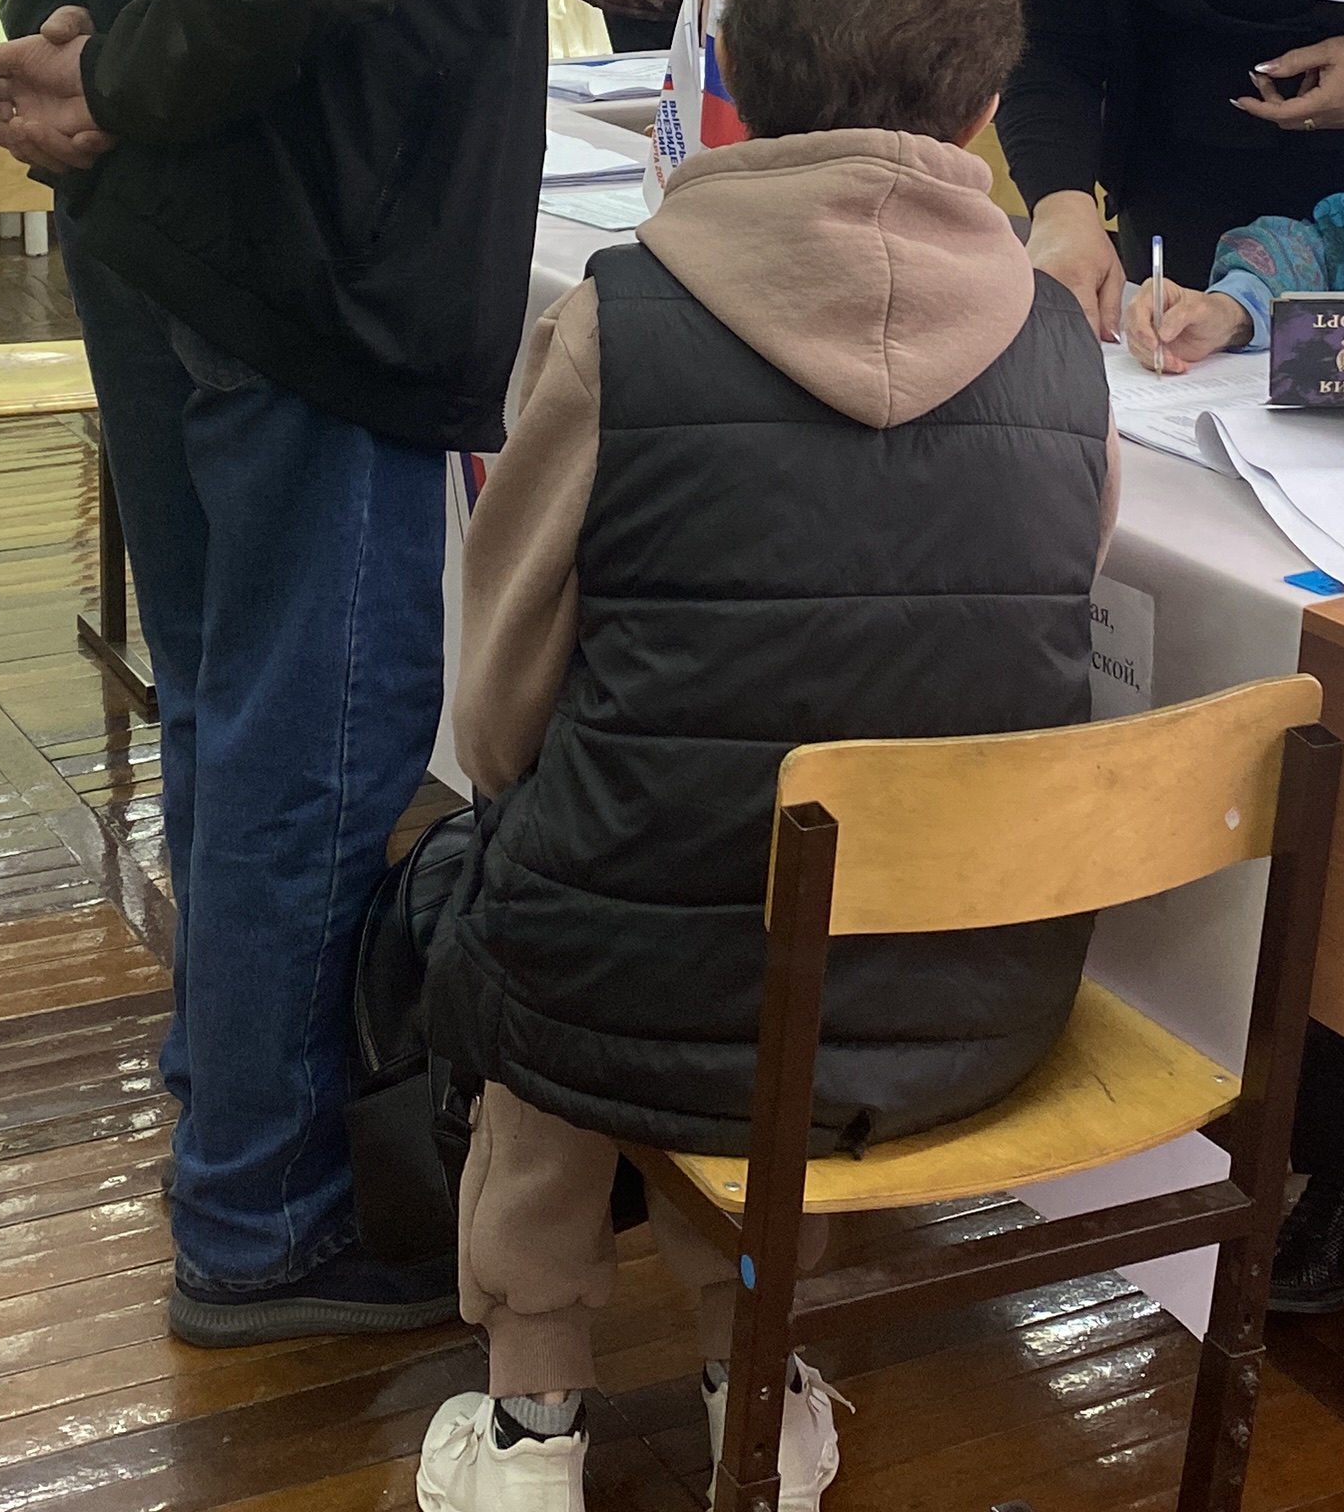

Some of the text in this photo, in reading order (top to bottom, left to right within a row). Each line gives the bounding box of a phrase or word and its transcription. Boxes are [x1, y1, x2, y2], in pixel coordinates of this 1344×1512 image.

[656, 105, 667, 156] ОССИИ
[1089, 603, 1114, 634] ая,
[1091, 651, 1140, 693] ской,
